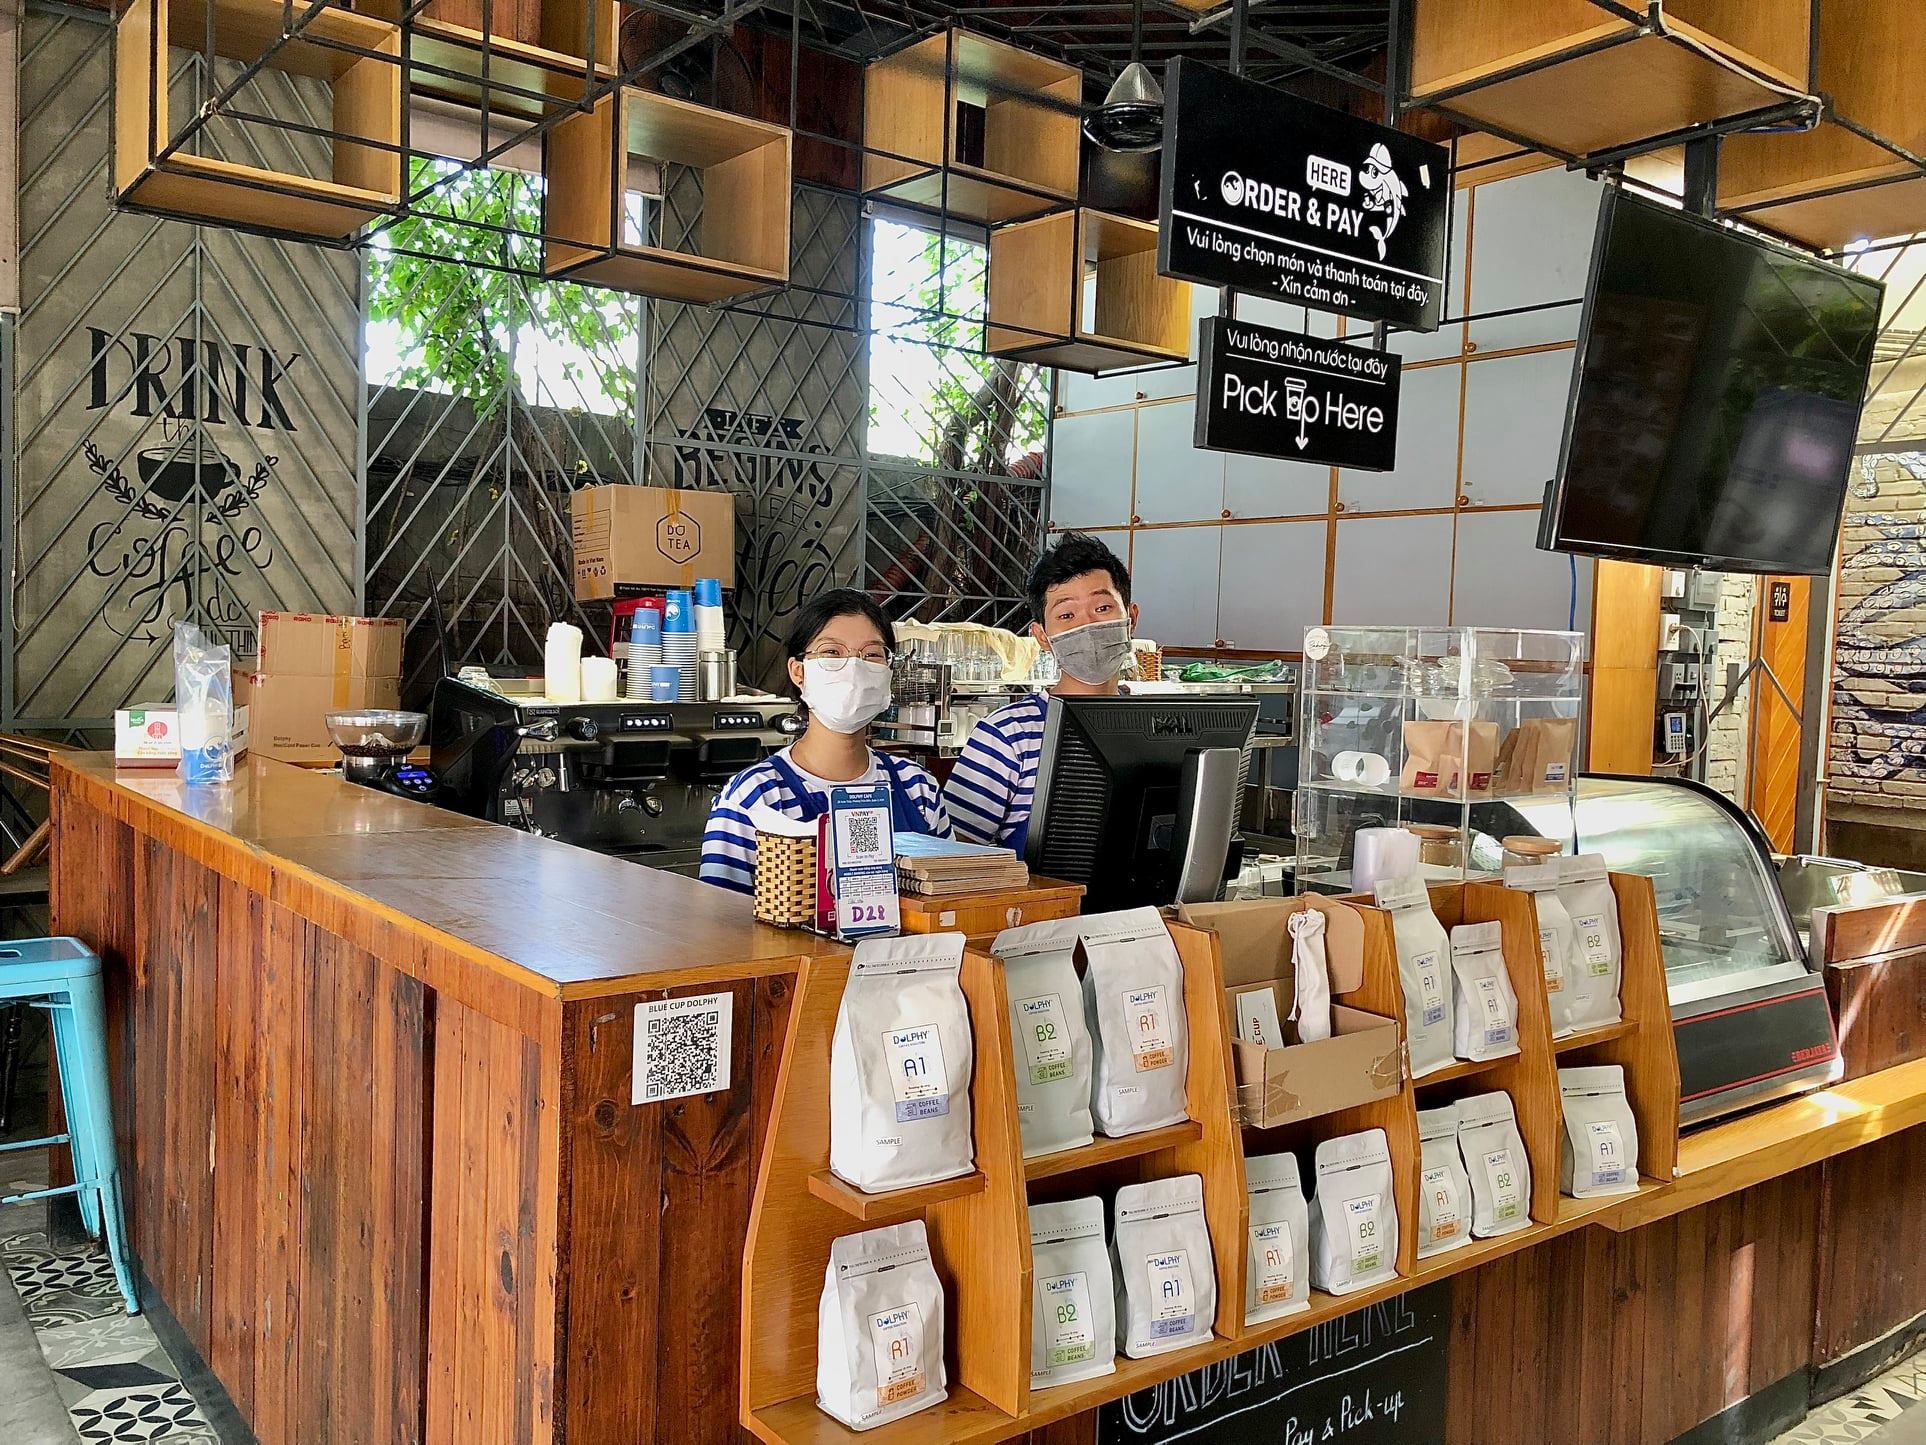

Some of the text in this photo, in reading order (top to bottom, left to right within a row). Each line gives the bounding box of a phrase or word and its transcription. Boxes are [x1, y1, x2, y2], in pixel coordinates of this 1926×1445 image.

[1311, 162, 1348, 191] HERE
[1306, 198, 1321, 227] &
[1327, 203, 1364, 237] PAY
[1187, 226, 1209, 246] Vui
[1212, 231, 1241, 261] lòng
[1244, 243, 1275, 266] chọn
[1277, 253, 1305, 272] món
[1307, 260, 1322, 277] và
[1325, 263, 1360, 286] thanh
[1362, 273, 1388, 293] toán
[1390, 281, 1406, 299] tại
[1280, 274, 1301, 296] Xin
[1304, 277, 1329, 302] cảm
[1332, 288, 1349, 307] ơn
[1227, 328, 1389, 380] Vui lòng nhận nước tại đây
[85, 326, 301, 432] DRINK
[1223, 373, 1278, 417] Pick
[1324, 391, 1384, 433] Here
[667, 538, 691, 551] TEA
[87, 522, 273, 623] Coffee
[1151, 714, 1193, 733] DELL
[1586, 934, 1602, 948] B2
[1423, 975, 1436, 991] A1
[649, 997, 718, 1013] BLUE CUP DOLPHY
[1139, 1013, 1156, 1032] R1
[1253, 1017, 1261, 1036] CUP
[1035, 1023, 1057, 1042] B2
[904, 1056, 926, 1077] A1
[918, 1098, 940, 1108] COFFEE
[920, 1107, 939, 1116] BEANS
[875, 1137, 901, 1146] SAMPLE
[1599, 1141, 1614, 1156] A1
[1497, 1172, 1512, 1189] B2
[1436, 1190, 1449, 1207] R1
[1359, 1220, 1375, 1239] B2
[1266, 1248, 1282, 1267] R1
[1162, 1279, 1180, 1299] A1
[1056, 1303, 1078, 1324] B2
[1169, 1318, 1186, 1327] COFFEE
[1169, 1325, 1185, 1334] BEANS
[891, 1337, 910, 1360] R1
[1067, 1345, 1087, 1355] COFFEE
[1067, 1353, 1085, 1361] BEANS
[896, 1379, 915, 1391] COFFEE
